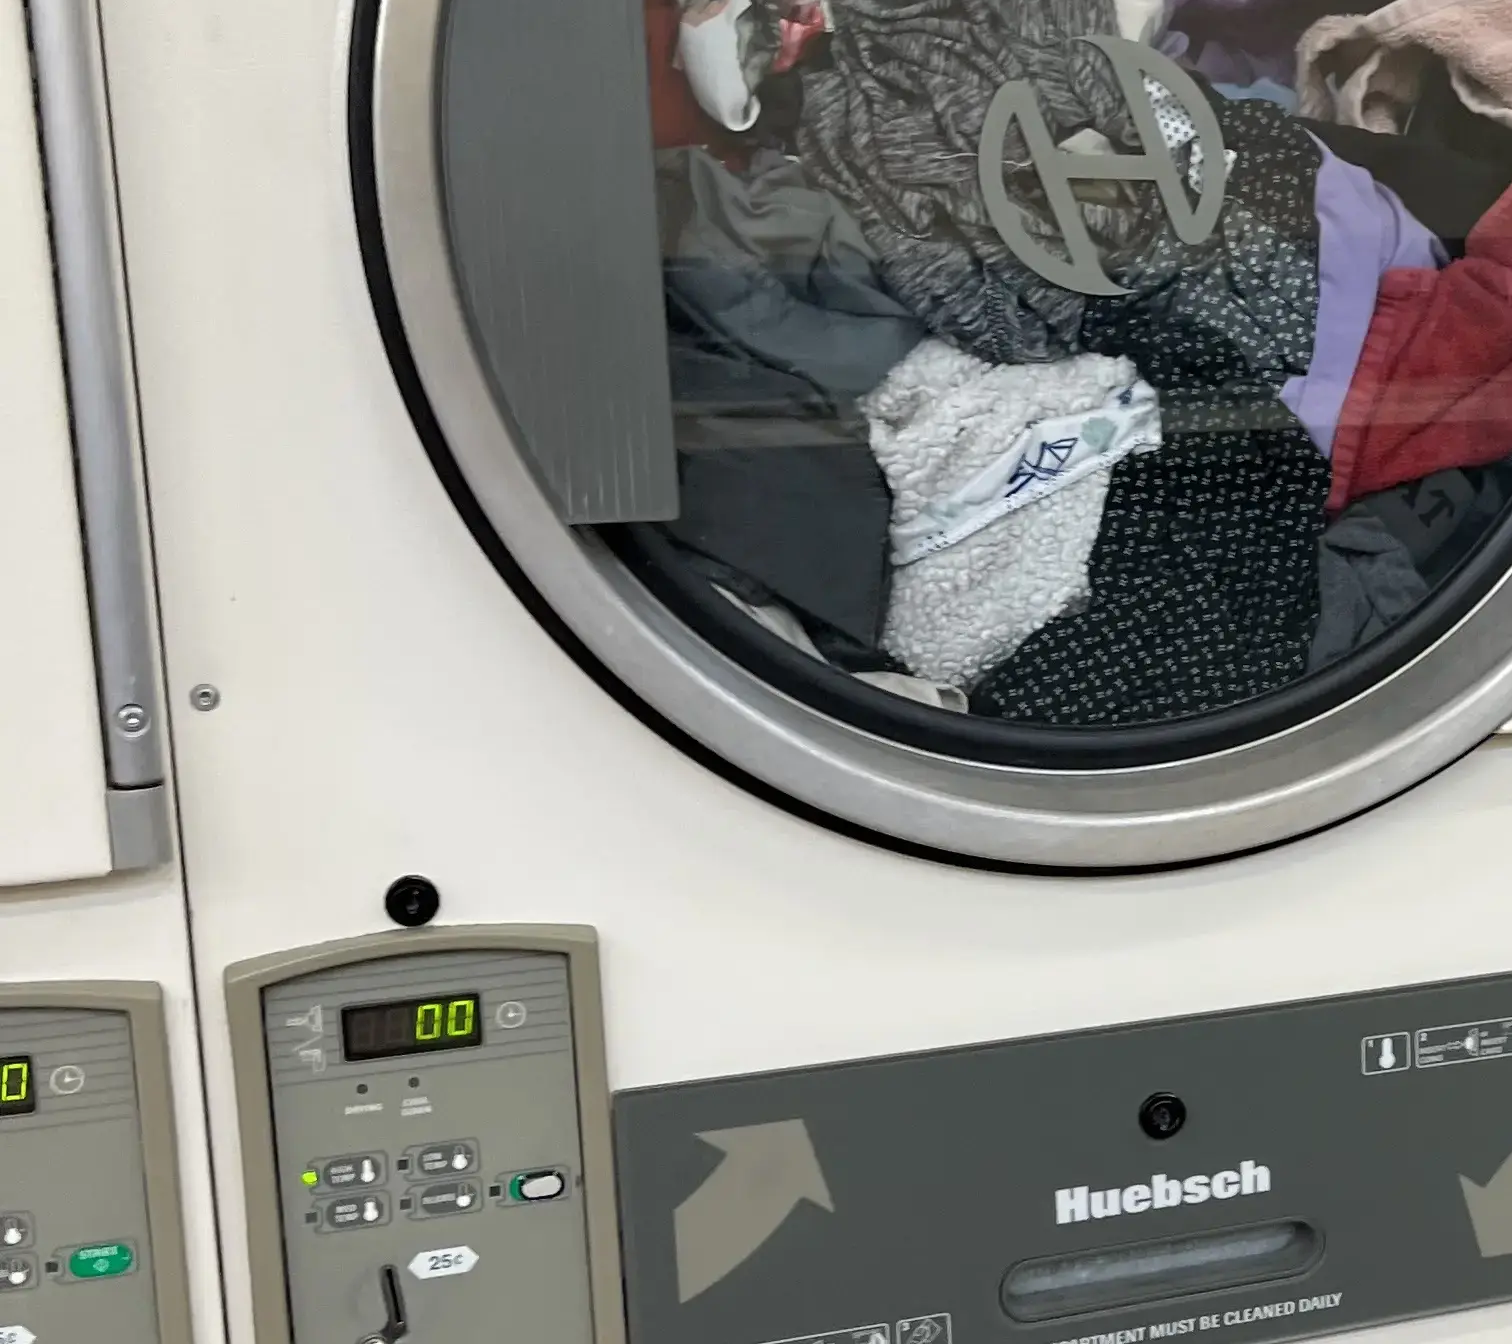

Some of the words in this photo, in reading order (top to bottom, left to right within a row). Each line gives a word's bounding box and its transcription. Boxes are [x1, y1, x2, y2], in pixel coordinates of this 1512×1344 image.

[416, 999, 475, 1041] 00
[1055, 1160, 1271, 1224] Huebsch
[1149, 1317, 1197, 1340] MUST
[1199, 1313, 1221, 1331] BE
[1223, 1300, 1296, 1326] CLEANED
[1298, 1292, 1343, 1313] DAILY
